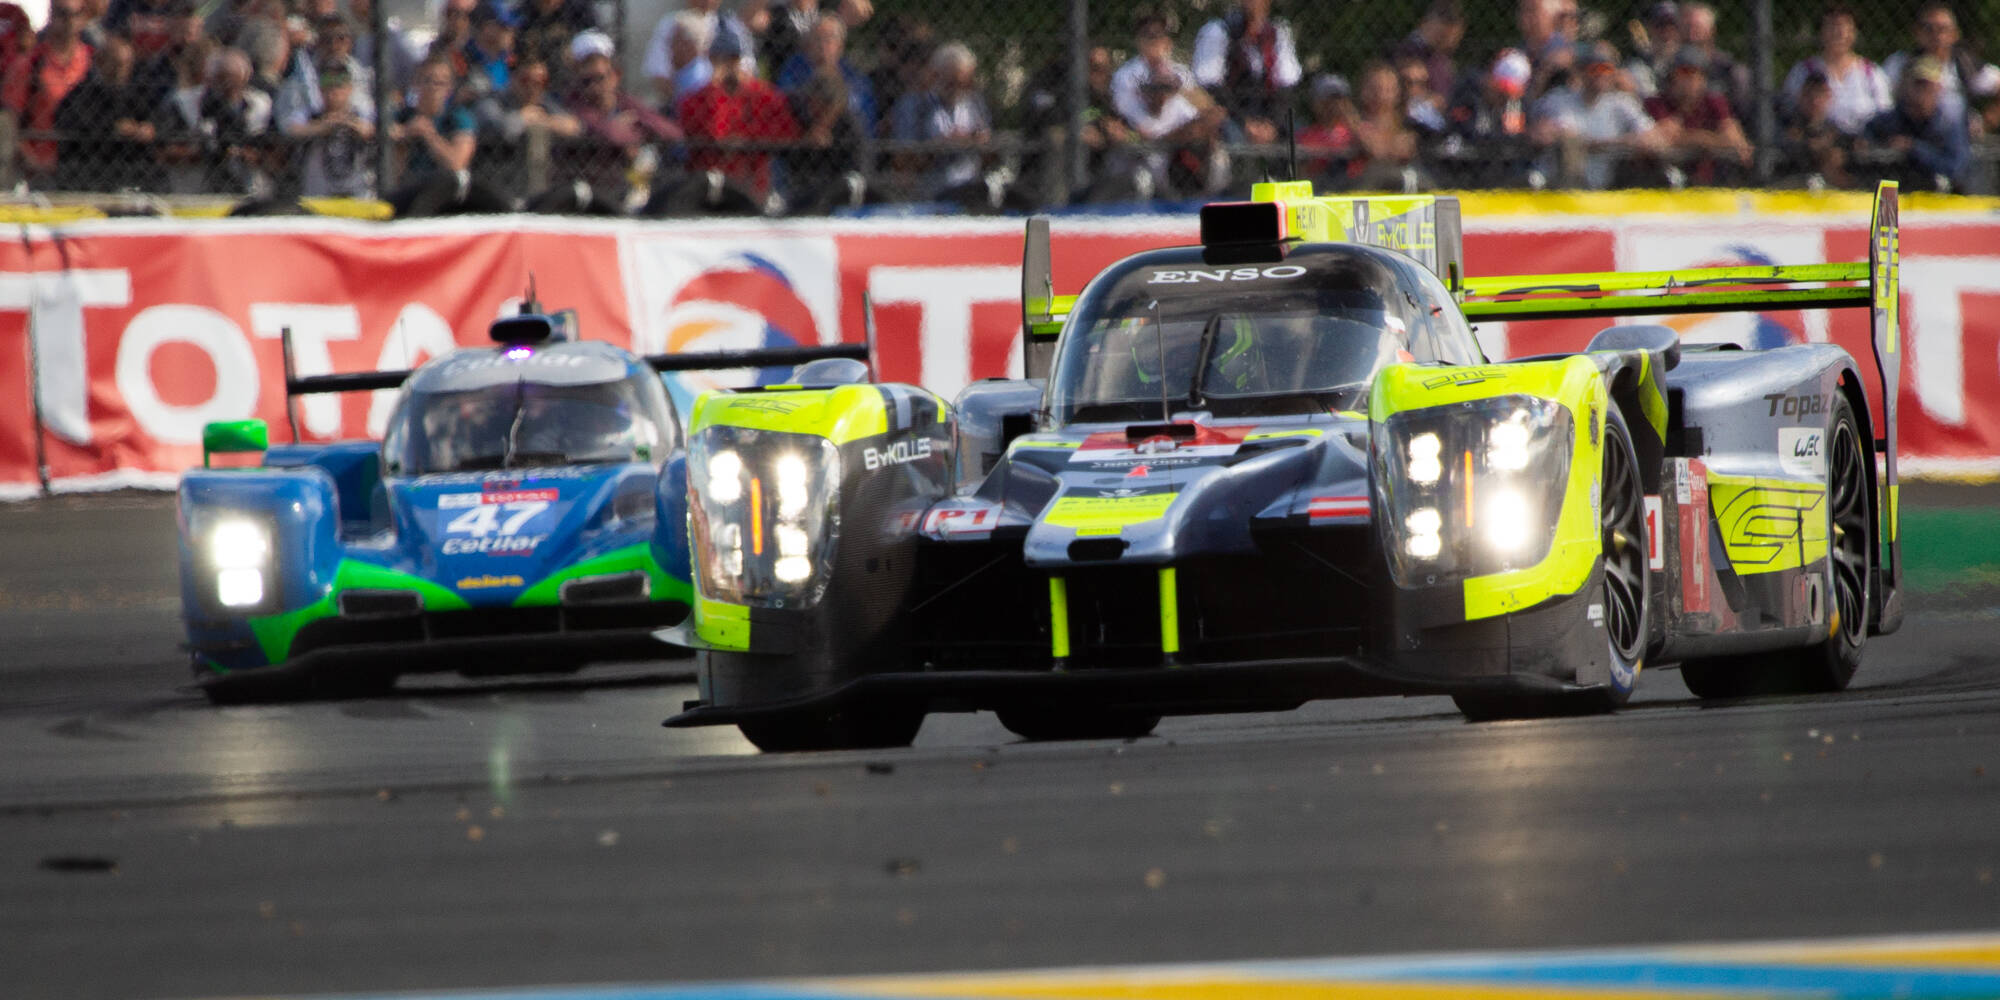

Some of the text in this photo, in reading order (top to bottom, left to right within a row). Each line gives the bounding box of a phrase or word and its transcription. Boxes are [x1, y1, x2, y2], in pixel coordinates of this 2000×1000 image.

[1147, 265, 1307, 284] ENSO
[1763, 393, 1830, 424] Topaz
[1794, 433, 1820, 457] WEC
[446, 501, 549, 537] 47
[934, 508, 990, 528] P1
[442, 536, 546, 555] Cetilar
